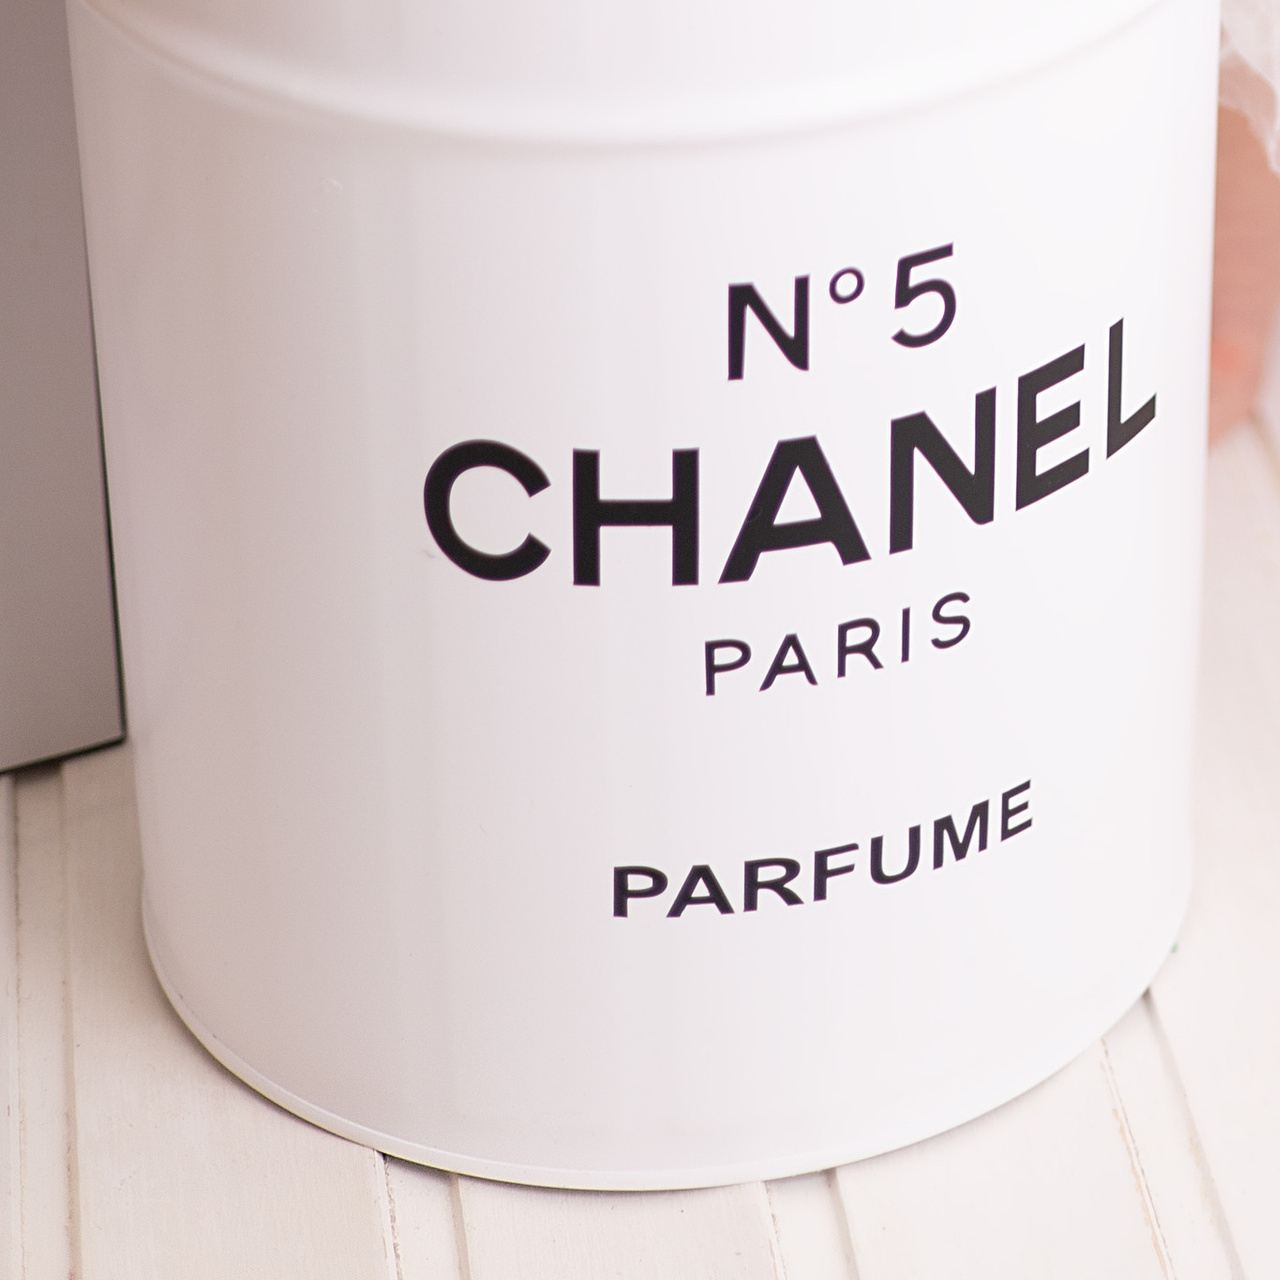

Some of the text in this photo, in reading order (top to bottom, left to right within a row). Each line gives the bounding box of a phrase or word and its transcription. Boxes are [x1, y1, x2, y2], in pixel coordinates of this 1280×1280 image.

[422, 317, 1158, 587] CHANEL
[703, 591, 972, 697] PARIS
[612, 779, 1034, 919] PARFUME
